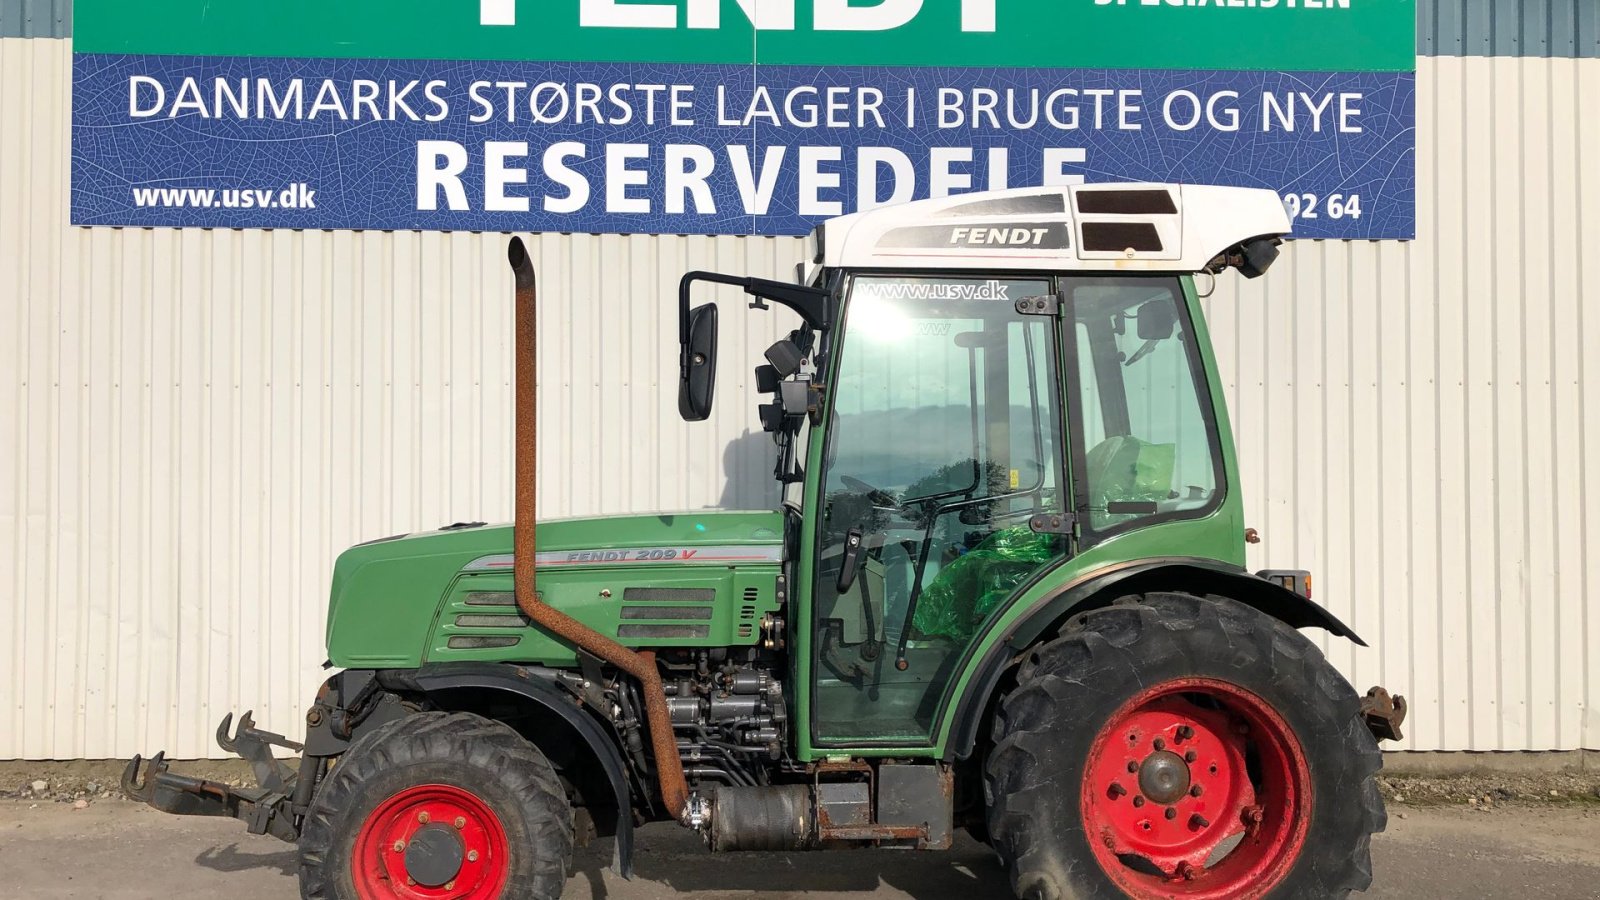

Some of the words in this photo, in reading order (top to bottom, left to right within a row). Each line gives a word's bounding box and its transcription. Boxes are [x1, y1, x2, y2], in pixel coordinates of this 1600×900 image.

[129, 75, 449, 122] DANMARKS
[469, 80, 694, 126] STØRSTE
[717, 85, 886, 128] LAGER
[907, 87, 915, 128] I
[938, 88, 1142, 131] BRUGTE
[1162, 89, 1239, 132] OG
[1263, 91, 1363, 134] NYE
[132, 183, 315, 209] www.usv.dk
[1284, 193, 1318, 219] 92
[1327, 194, 1361, 219] 64
[950, 227, 1049, 245] FENDT
[858, 280, 1009, 300] www.usv.dk
[567, 550, 630, 563] FENDT
[635, 550, 677, 560] 209
[681, 550, 697, 560] V
